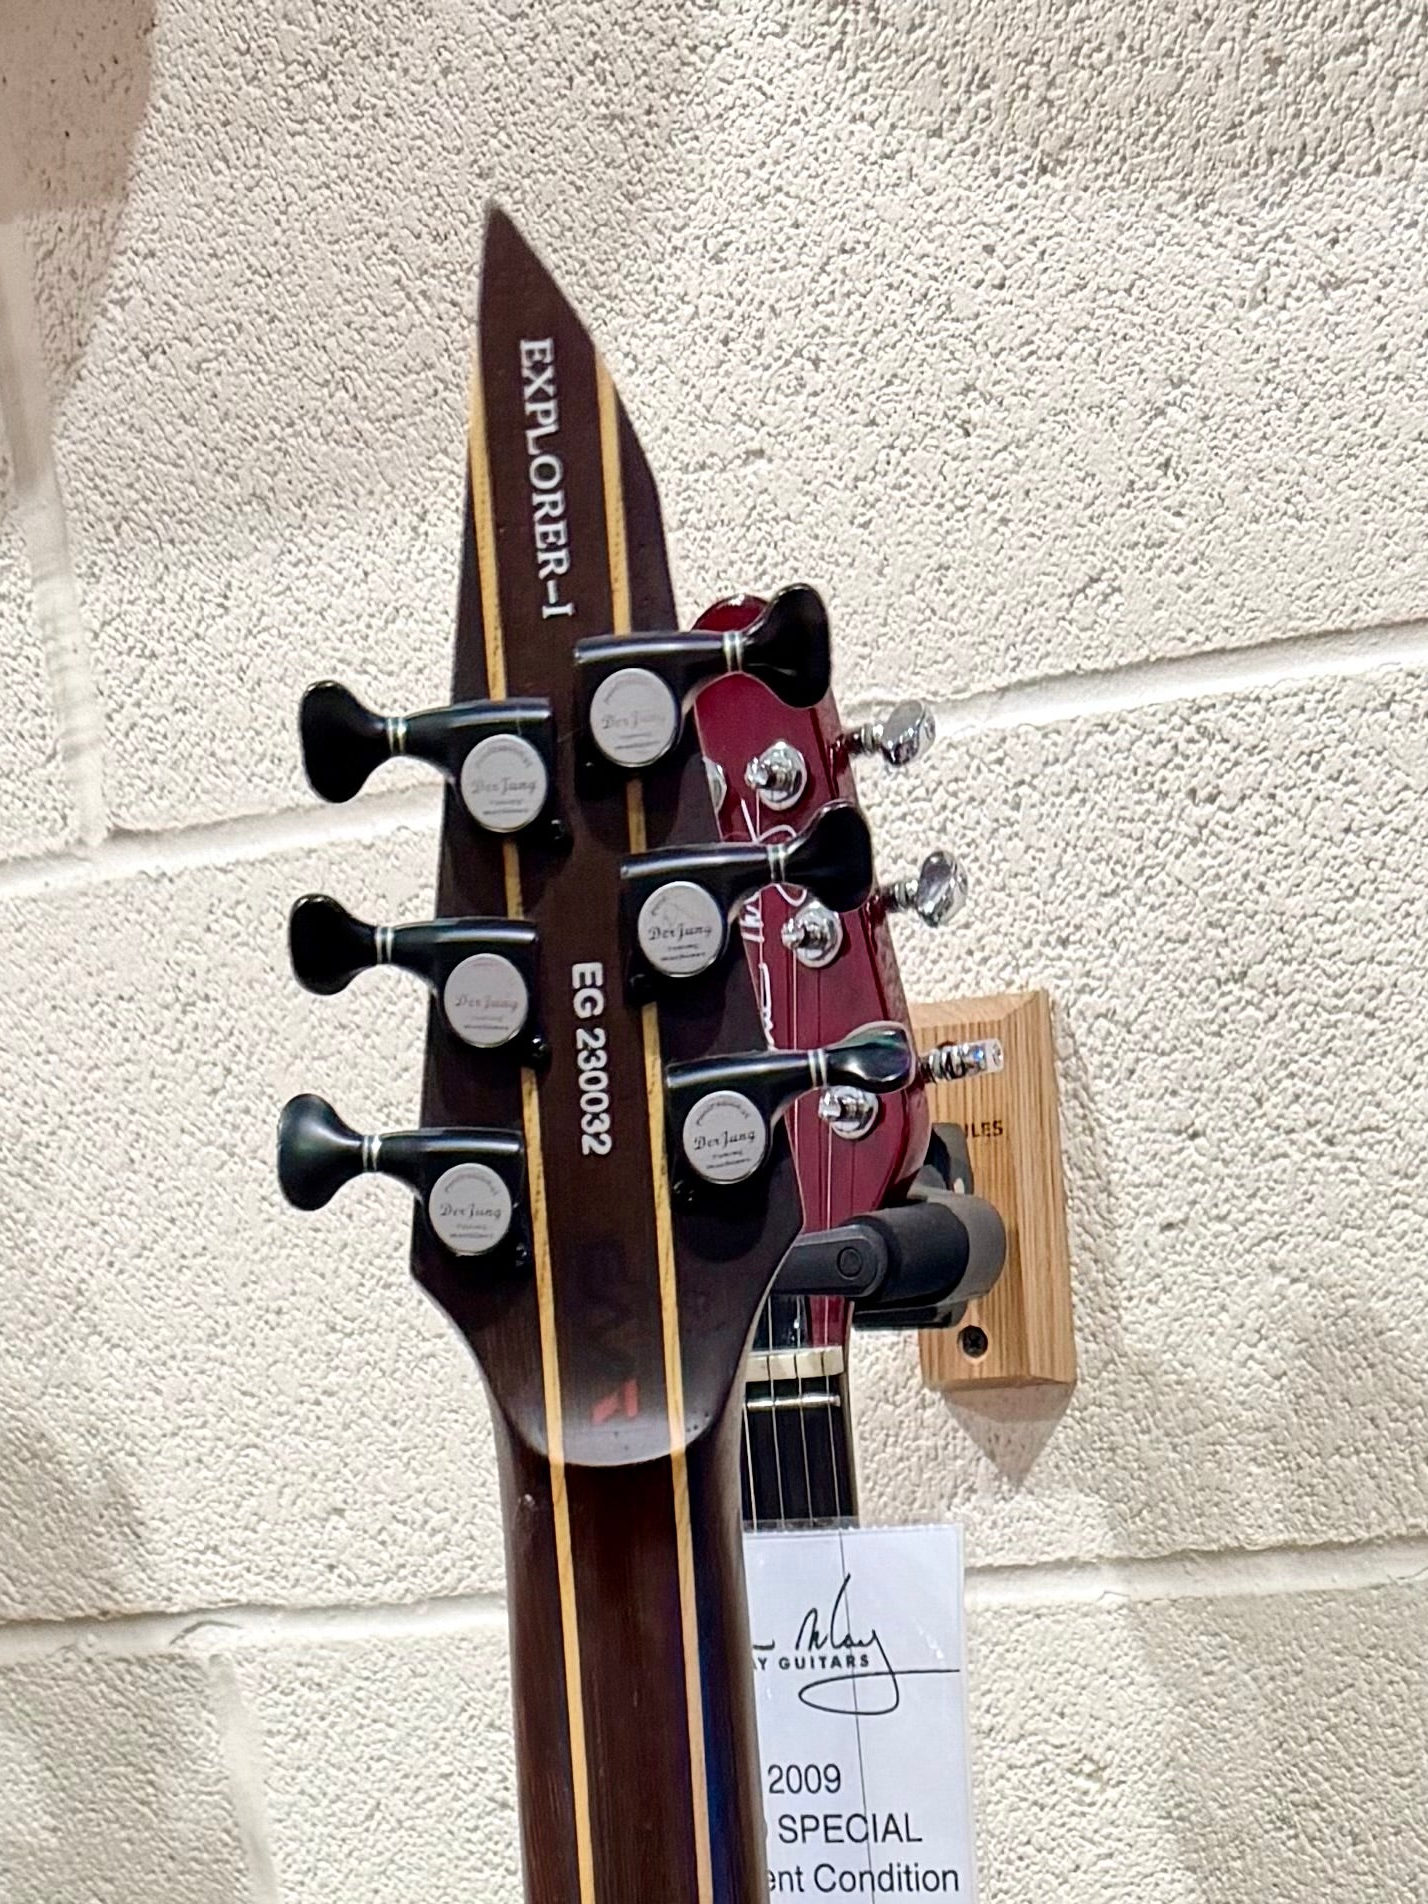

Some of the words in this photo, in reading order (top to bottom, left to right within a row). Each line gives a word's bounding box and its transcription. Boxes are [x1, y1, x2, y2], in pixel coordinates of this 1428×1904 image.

[519, 336, 574, 620] EXPLORER-I
[571, 960, 605, 1020] EG
[574, 1025, 614, 1158] 230032
[778, 1654, 870, 1670] GUITARS
[767, 1763, 841, 1795] 2009
[777, 1812, 924, 1844] SPECIAL
[813, 1862, 960, 1894] Condition
